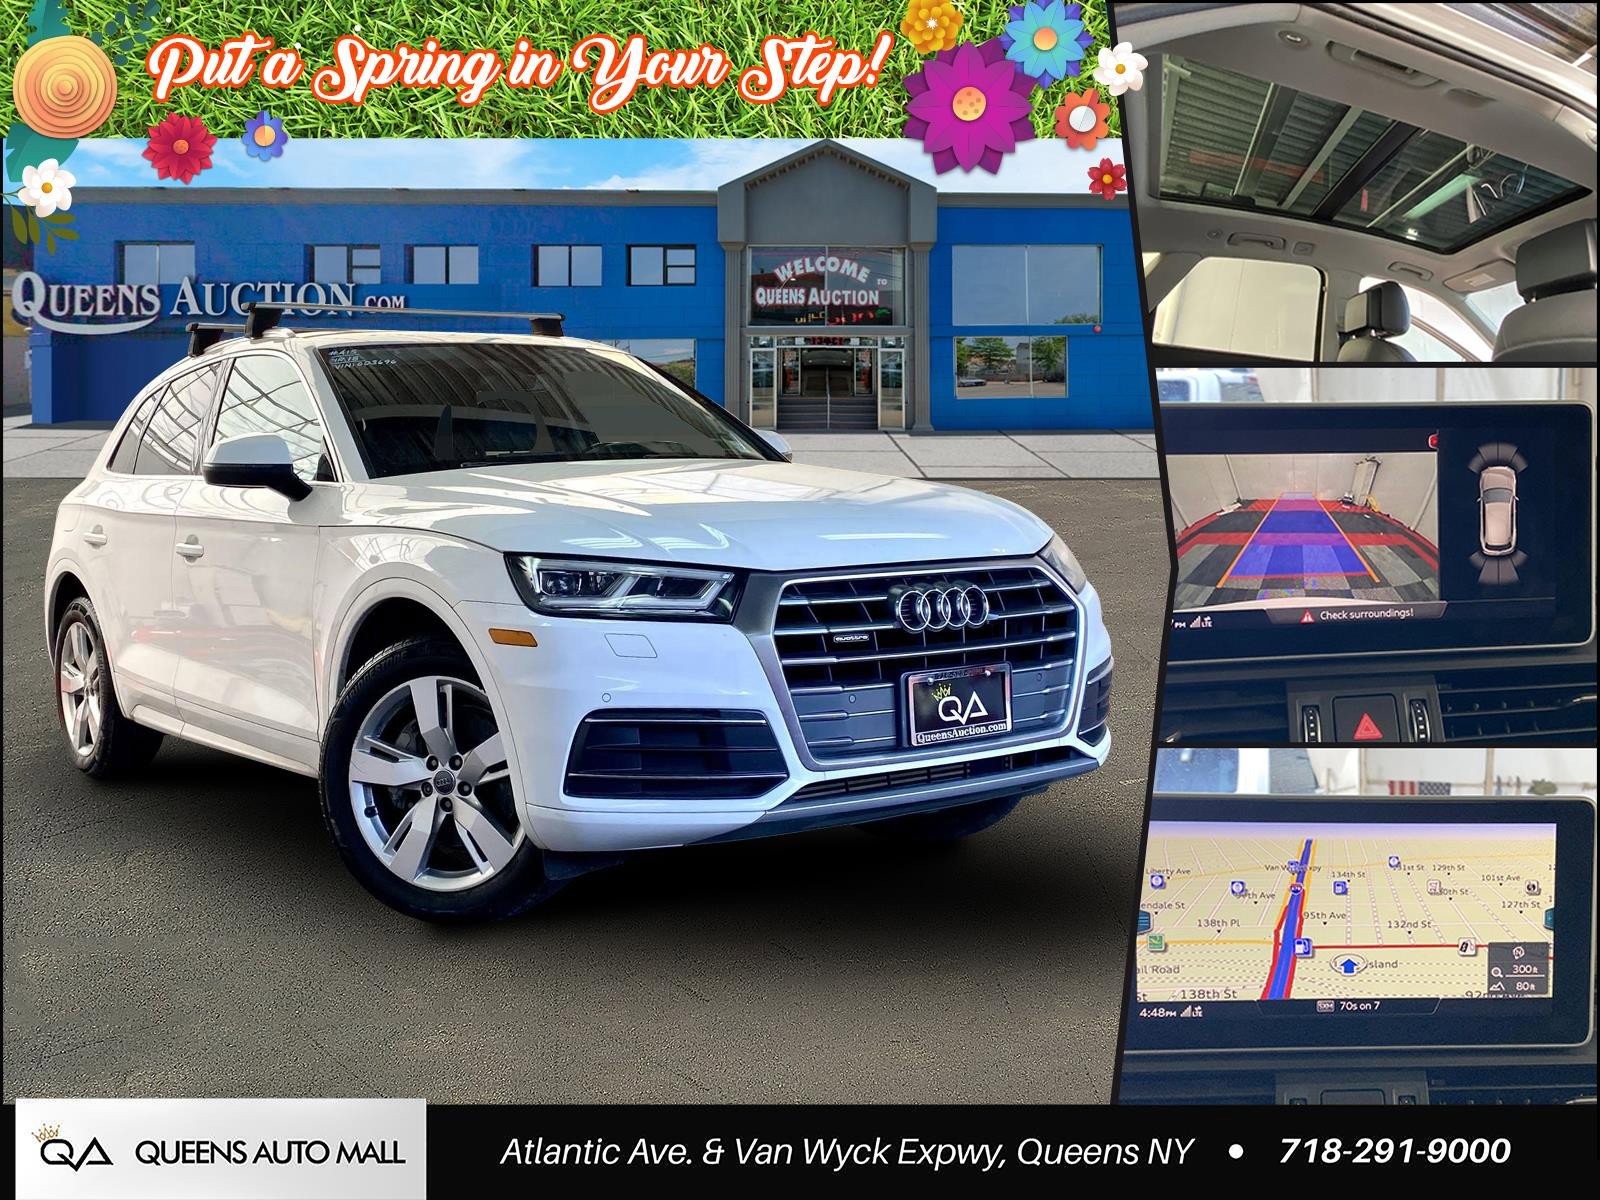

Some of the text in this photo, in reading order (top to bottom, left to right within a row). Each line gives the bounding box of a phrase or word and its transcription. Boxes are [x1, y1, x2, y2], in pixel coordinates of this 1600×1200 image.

[774, 256, 888, 286] WELCOME TO
[755, 286, 880, 305] QUEENS AUCTION
[10, 272, 161, 335] QUEENS
[170, 276, 357, 317] AUCTION
[1320, 608, 1414, 621] Check surroundings!
[835, 634, 869, 642] quattro
[917, 722, 1007, 743] QueensAuction.com
[1146, 867, 1174, 876] Liberty
[1331, 871, 1366, 879] 134th St
[1481, 874, 1504, 882] 101st
[1259, 891, 1276, 899] Ave
[1459, 888, 1469, 896] St
[1175, 902, 1186, 910] St
[1501, 901, 1541, 909] 127th St
[1303, 911, 1347, 920] 95th Ave
[1197, 919, 1228, 928] 138th
[1387, 920, 1432, 929] 132nd St
[1367, 959, 1399, 969] sland
[1152, 964, 1180, 974] Road
[1180, 988, 1238, 999] 138th St
[1340, 1001, 1358, 1010] 70s
[1373, 1001, 1380, 1010] 7
